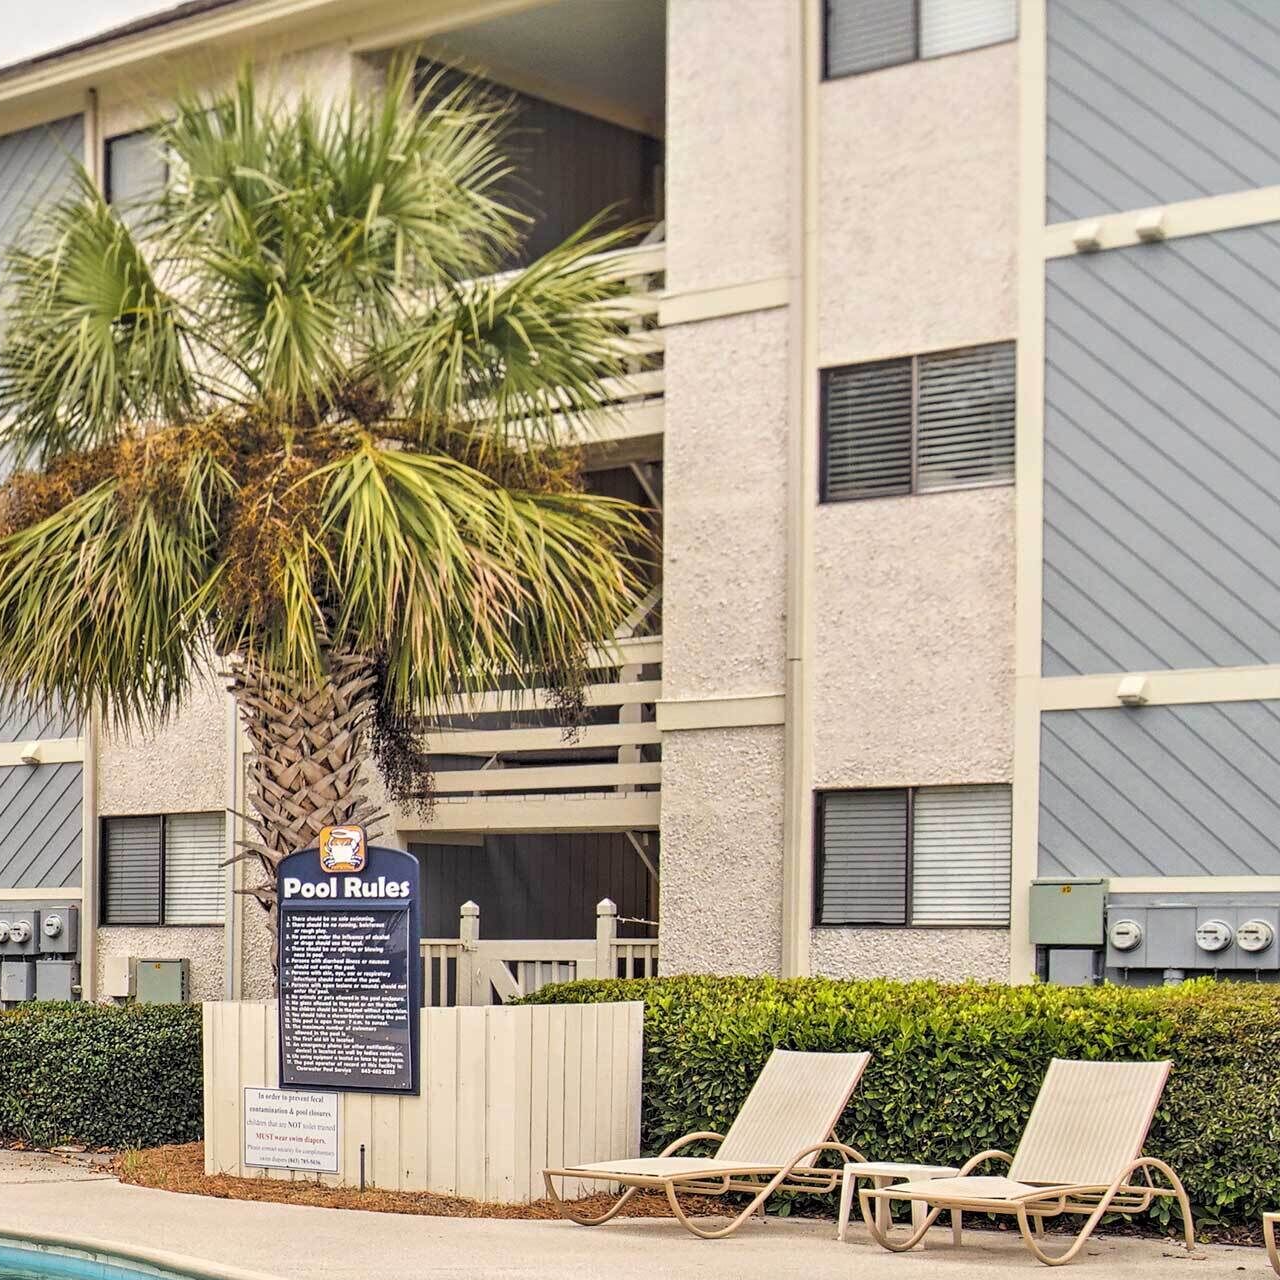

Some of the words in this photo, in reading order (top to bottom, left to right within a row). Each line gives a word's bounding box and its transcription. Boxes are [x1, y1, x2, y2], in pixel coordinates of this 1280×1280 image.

[283, 877, 338, 898] Pool
[344, 876, 410, 898] Rules
[287, 1121, 301, 1129] NOT
[255, 1132, 273, 1140] MUST
